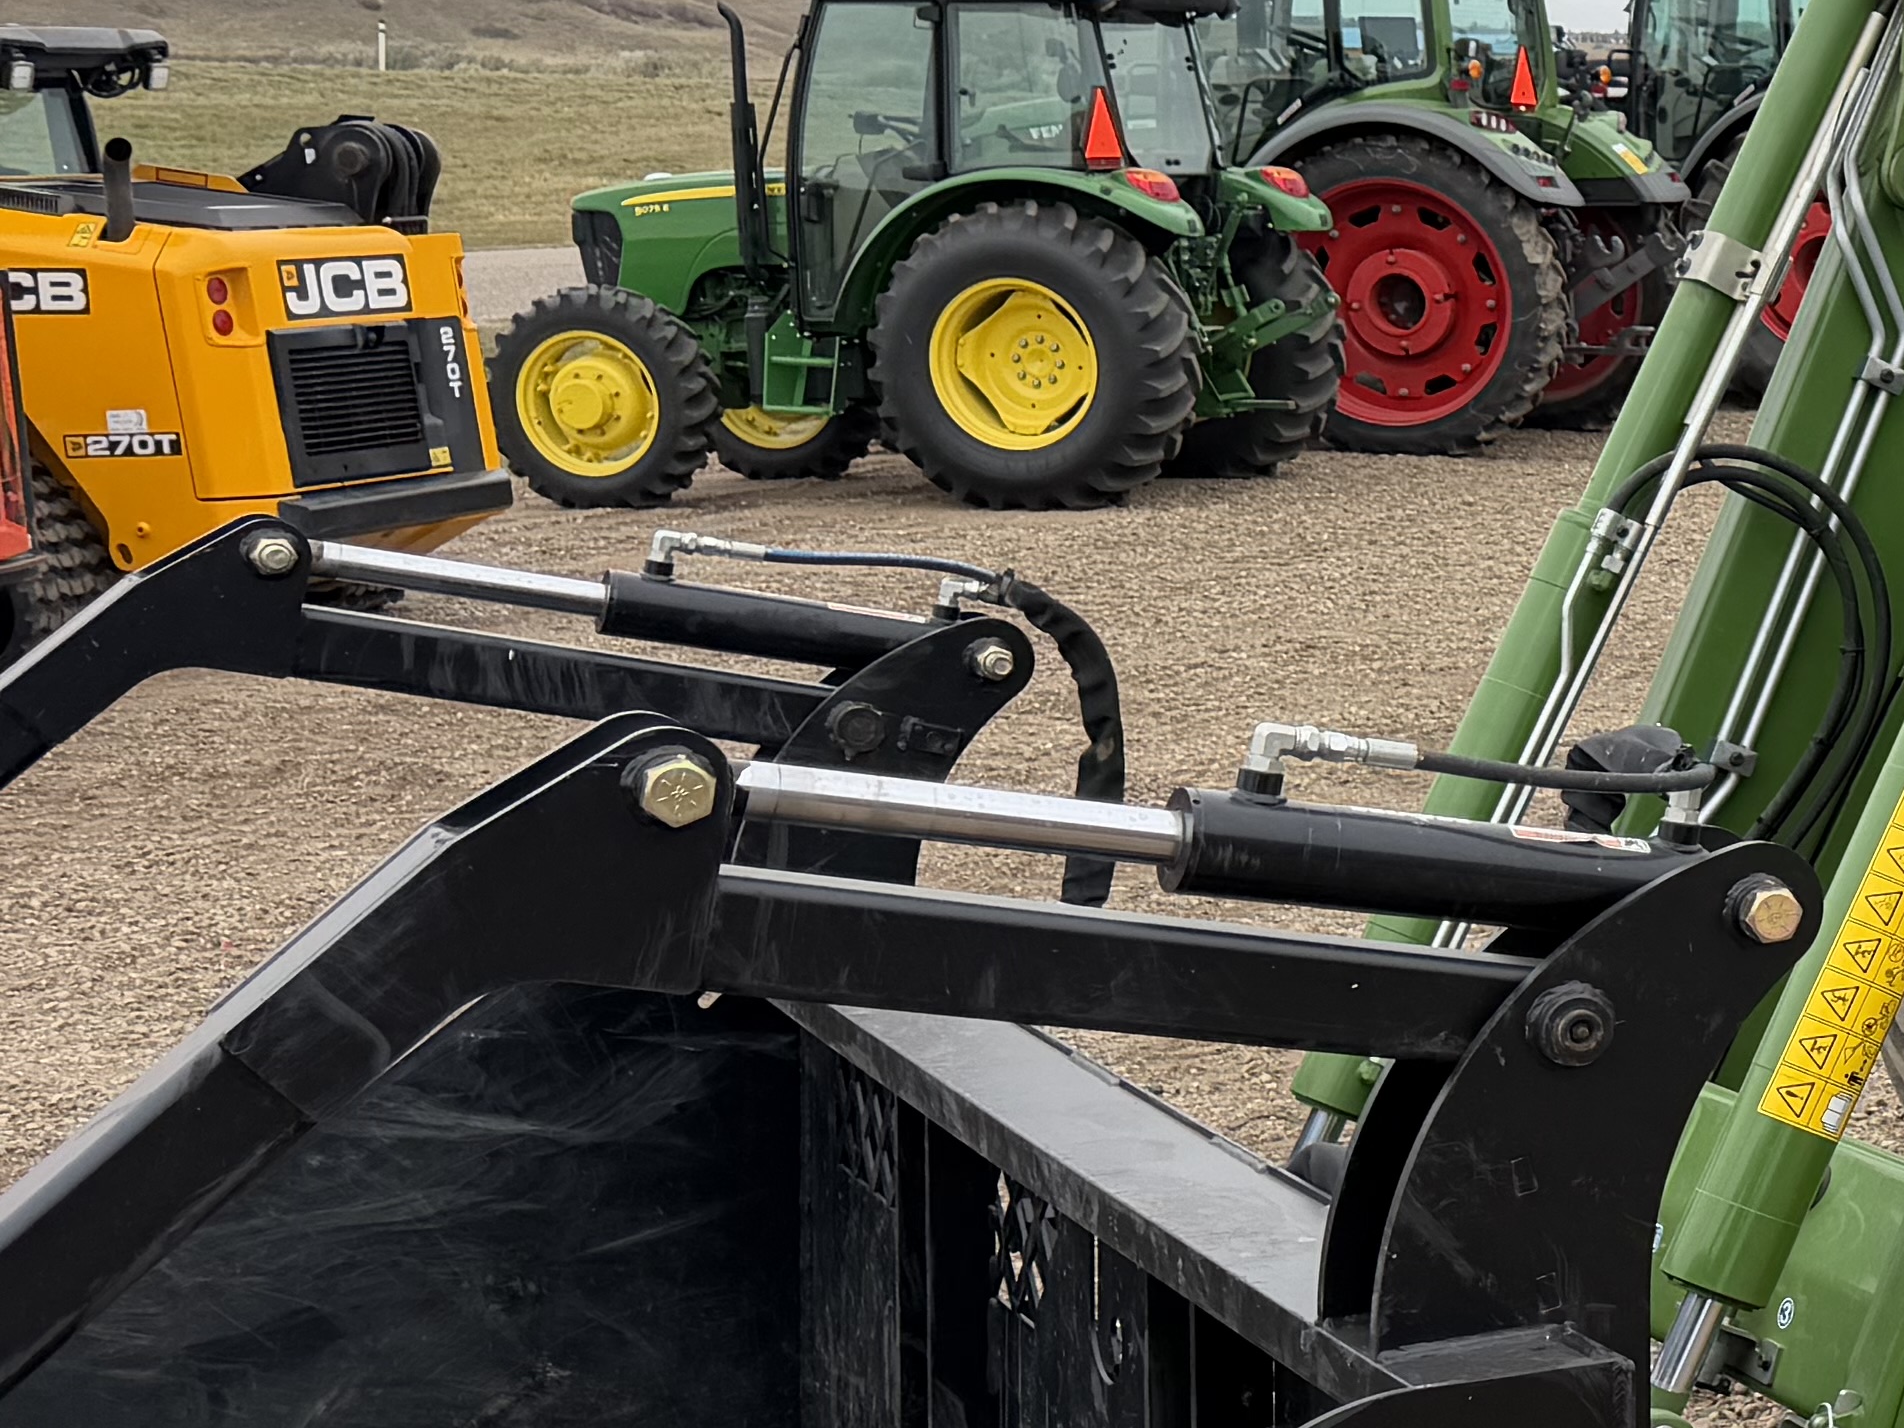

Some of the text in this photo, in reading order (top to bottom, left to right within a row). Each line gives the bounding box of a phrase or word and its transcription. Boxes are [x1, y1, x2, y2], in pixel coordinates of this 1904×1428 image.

[285, 259, 408, 315] JCB
[439, 326, 462, 398] 270T
[86, 434, 177, 456] 270T
